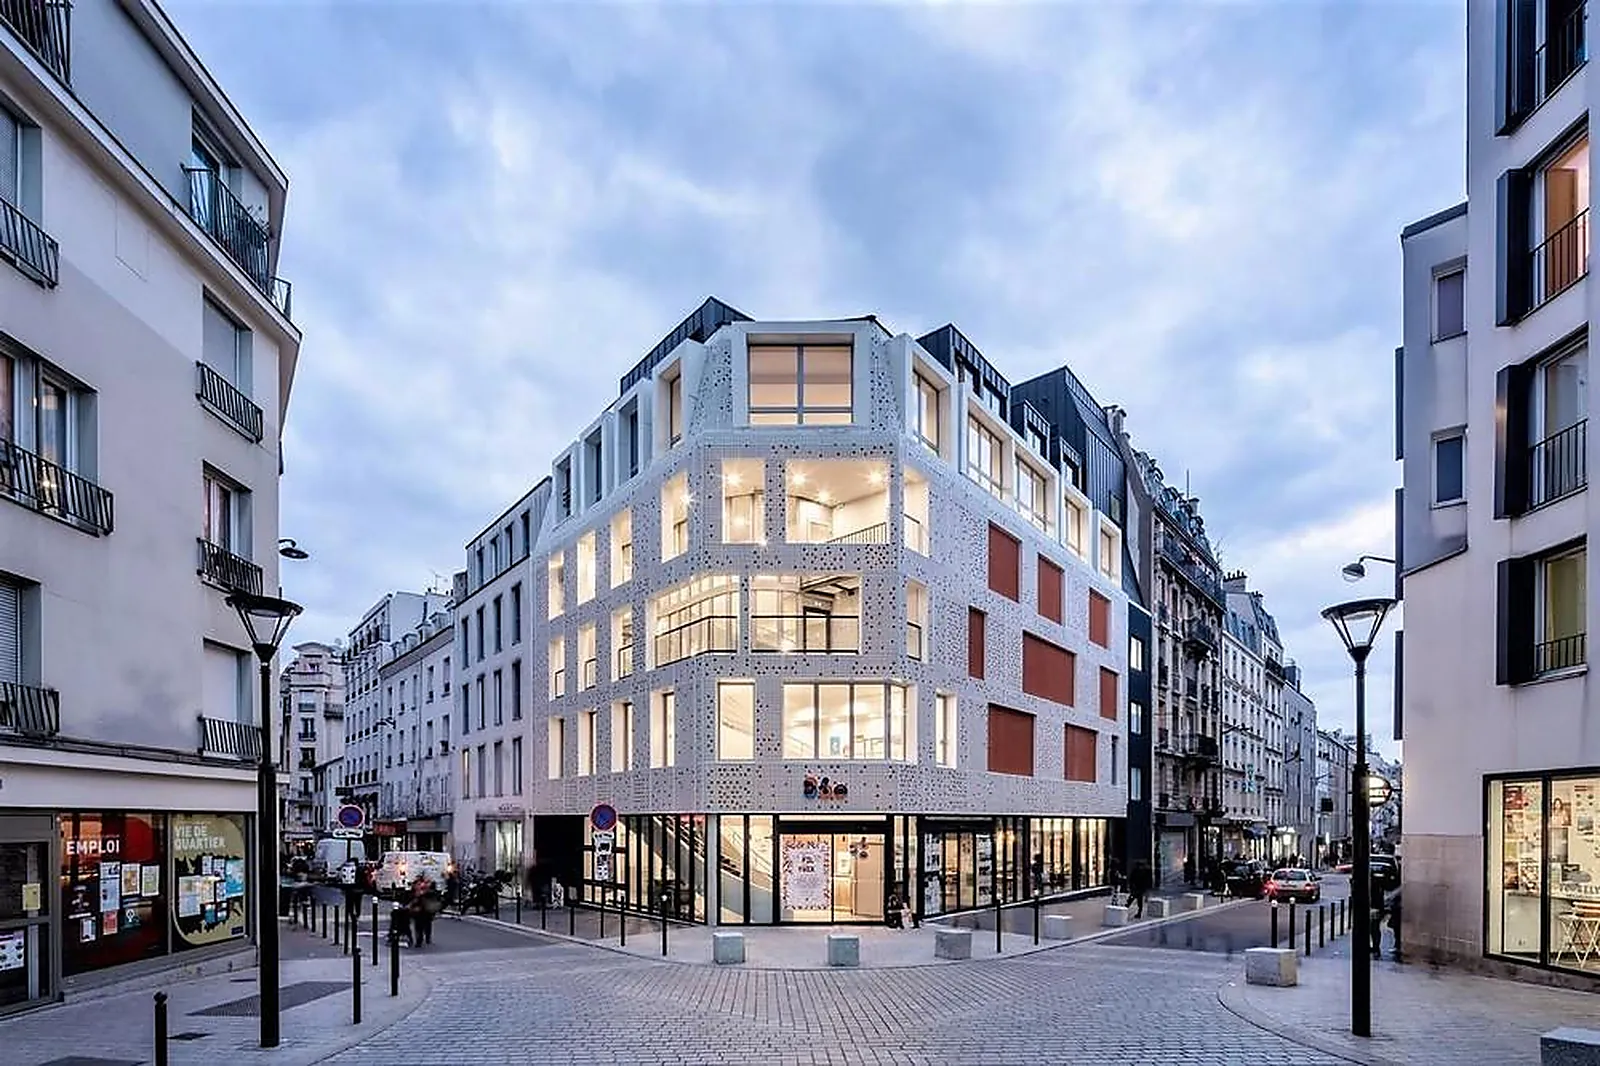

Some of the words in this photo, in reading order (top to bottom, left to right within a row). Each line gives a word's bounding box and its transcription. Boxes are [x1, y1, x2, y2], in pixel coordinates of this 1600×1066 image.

[175, 825, 192, 838] VIE
[193, 825, 208, 837] DE
[66, 839, 120, 855] EMPLOI
[174, 836, 226, 851] QUARTIER
